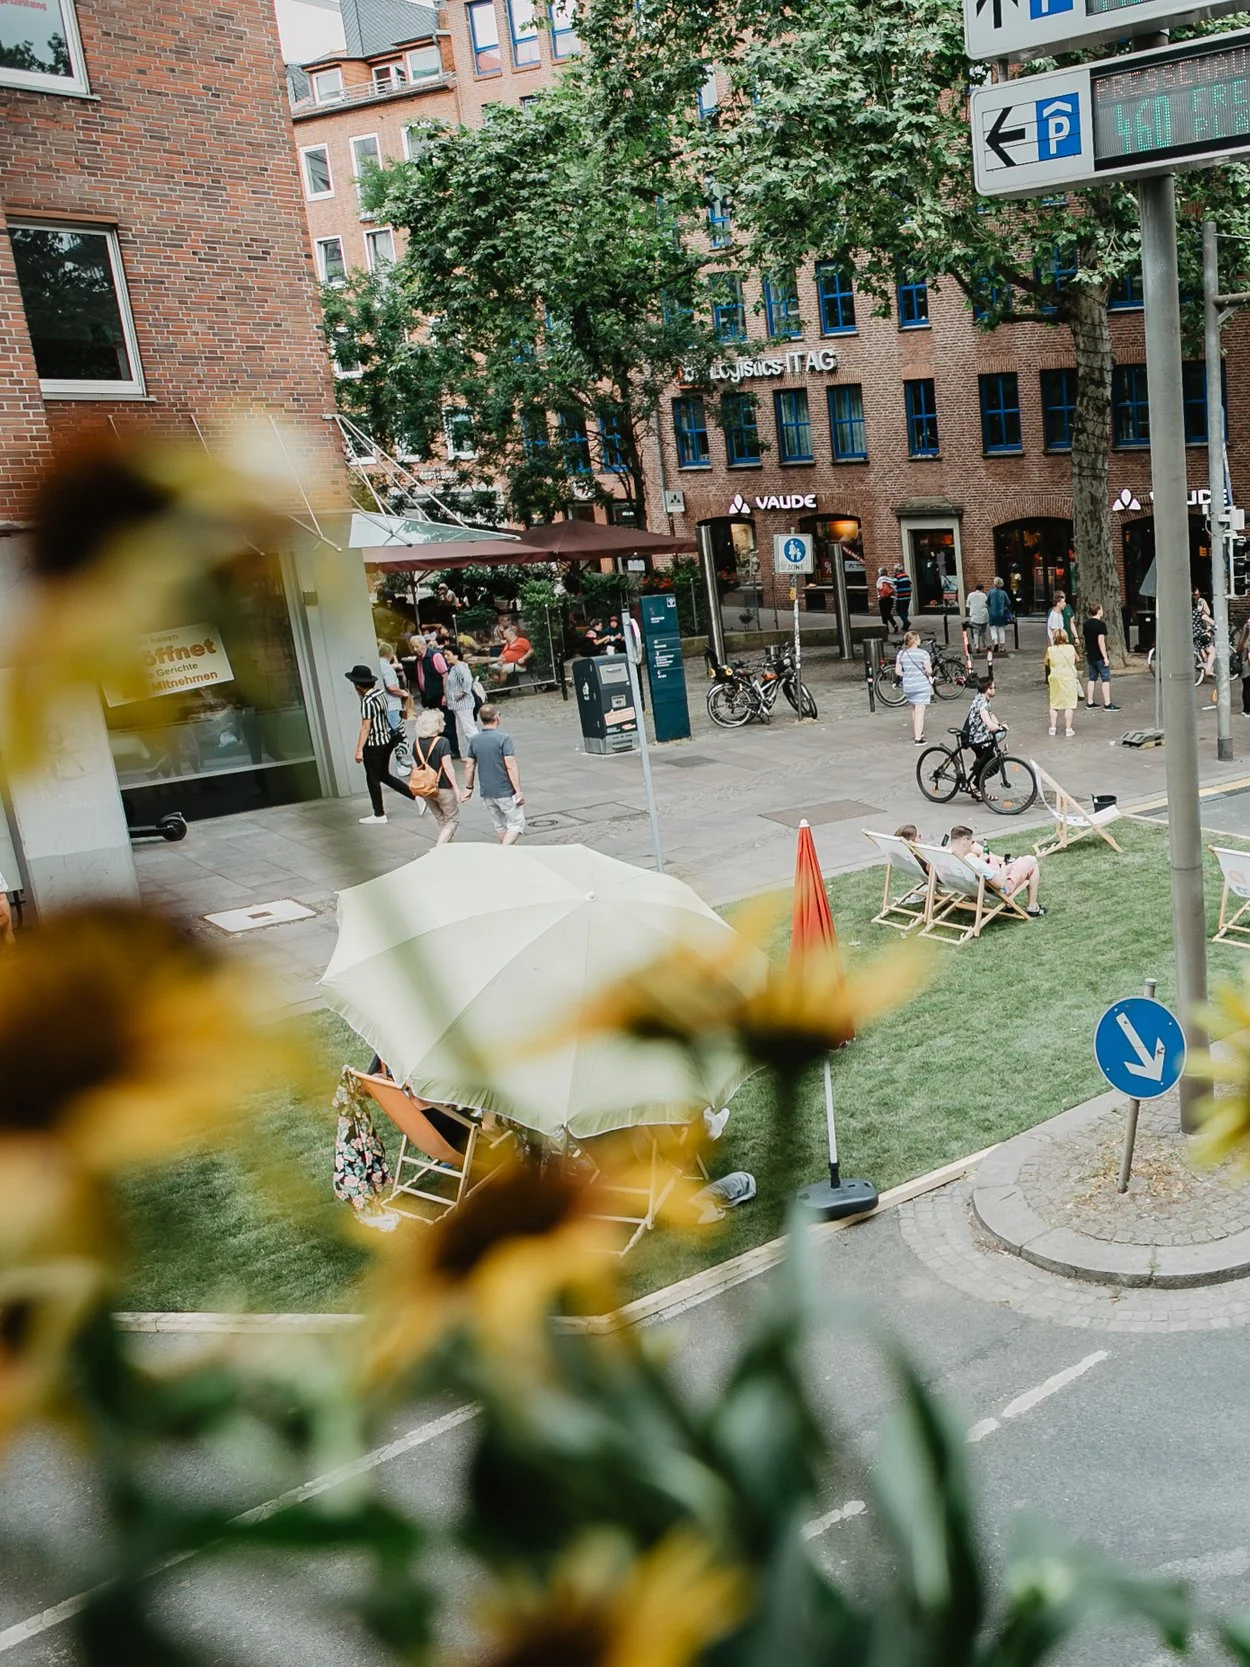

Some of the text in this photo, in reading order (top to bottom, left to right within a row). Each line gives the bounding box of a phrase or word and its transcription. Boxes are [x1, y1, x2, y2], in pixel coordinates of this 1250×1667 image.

[1115, 95, 1171, 153] 460
[786, 352, 803, 373] IT
[806, 350, 838, 372] AG
[755, 494, 817, 509] VAUDE
[144, 638, 217, 667] öffnet
[156, 662, 198, 677] Gerichte
